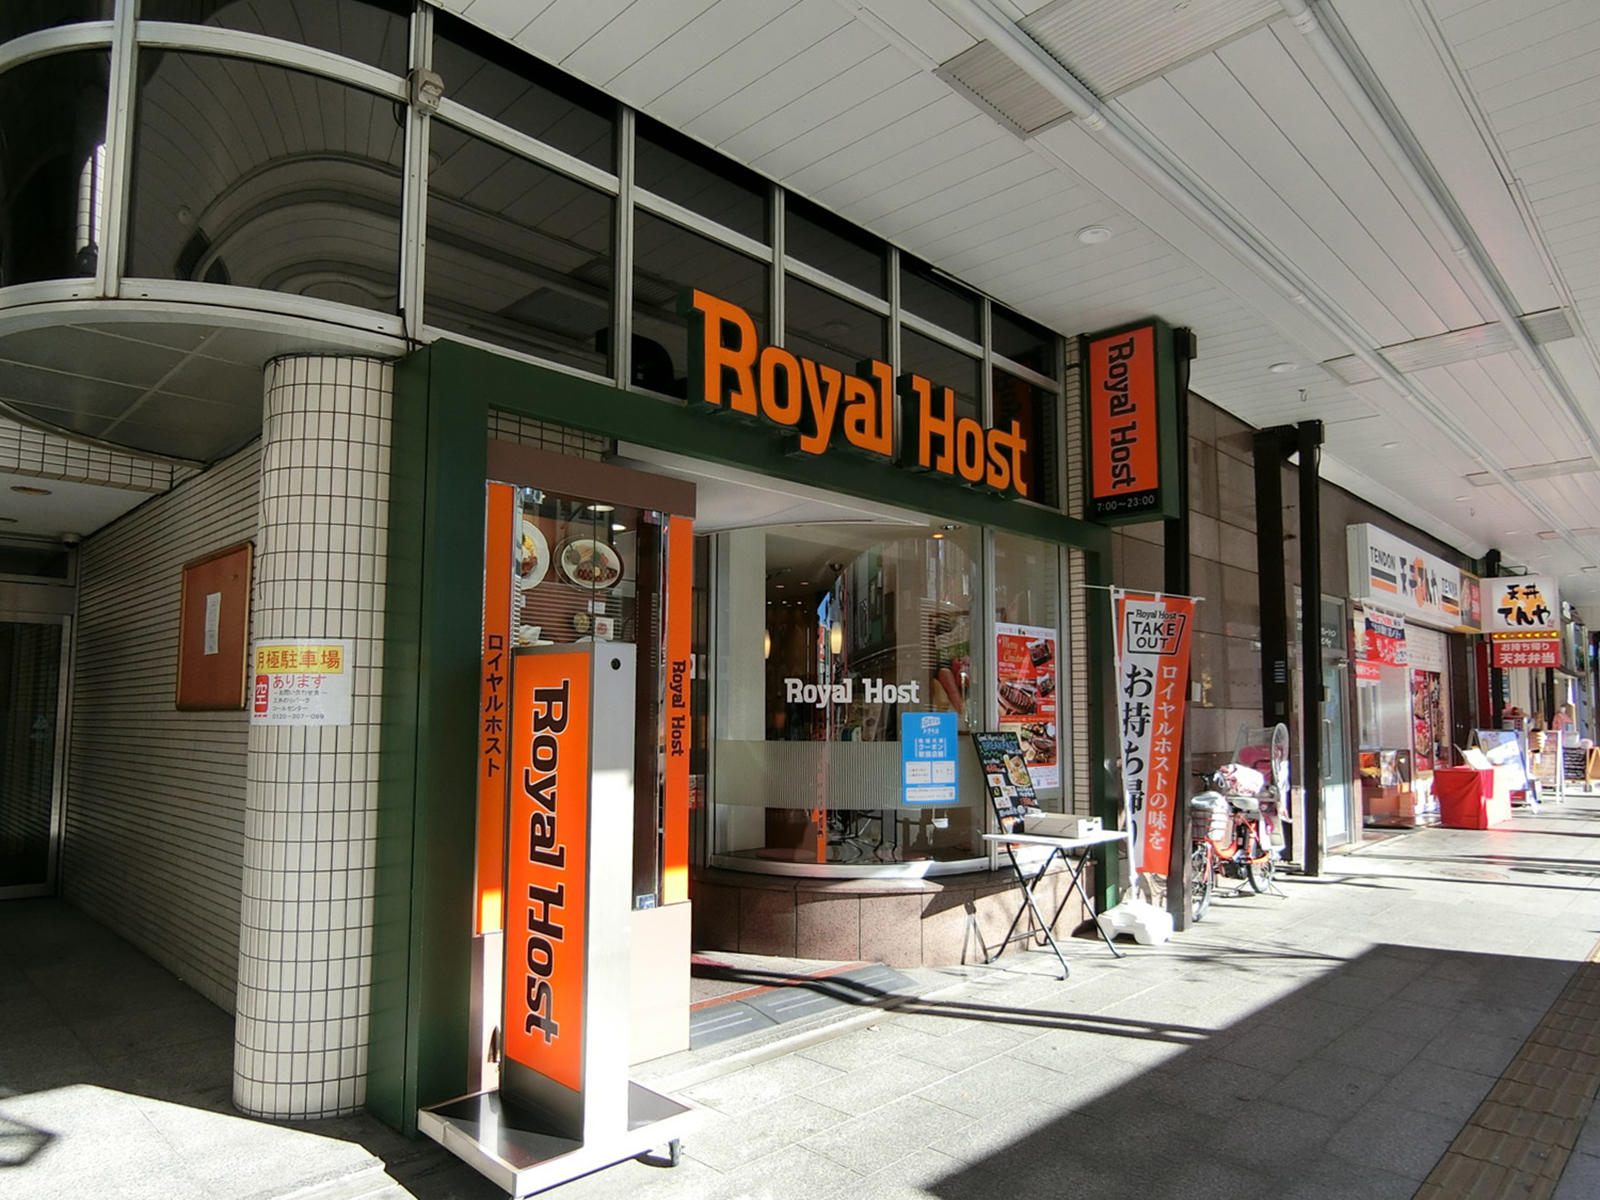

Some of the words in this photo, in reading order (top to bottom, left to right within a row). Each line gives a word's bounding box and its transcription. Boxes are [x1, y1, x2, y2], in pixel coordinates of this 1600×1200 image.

[693, 288, 893, 457] Royal
[911, 373, 1027, 497] Host
[1104, 337, 1137, 417] Royal
[1110, 421, 1137, 490] Host
[1506, 582, 1540, 601] 天丼
[1132, 621, 1176, 637] TAKE
[1135, 609, 1157, 620] Royal
[1158, 610, 1177, 620] Host
[1497, 604, 1552, 627] てんや
[256, 650, 341, 670] 月極駐車場
[1136, 636, 1169, 649] OUT
[1500, 652, 1555, 664] 天丼弁当
[273, 674, 327, 690] あります
[669, 660, 686, 708] Royal
[784, 678, 852, 708] Royal
[862, 678, 920, 704] Host
[484, 635, 503, 778] ロイヤルホスト
[671, 715, 685, 757] Host
[524, 678, 570, 870] Royal
[1148, 665, 1178, 850] ロイヤルホストの味を
[525, 883, 565, 1044] Host
